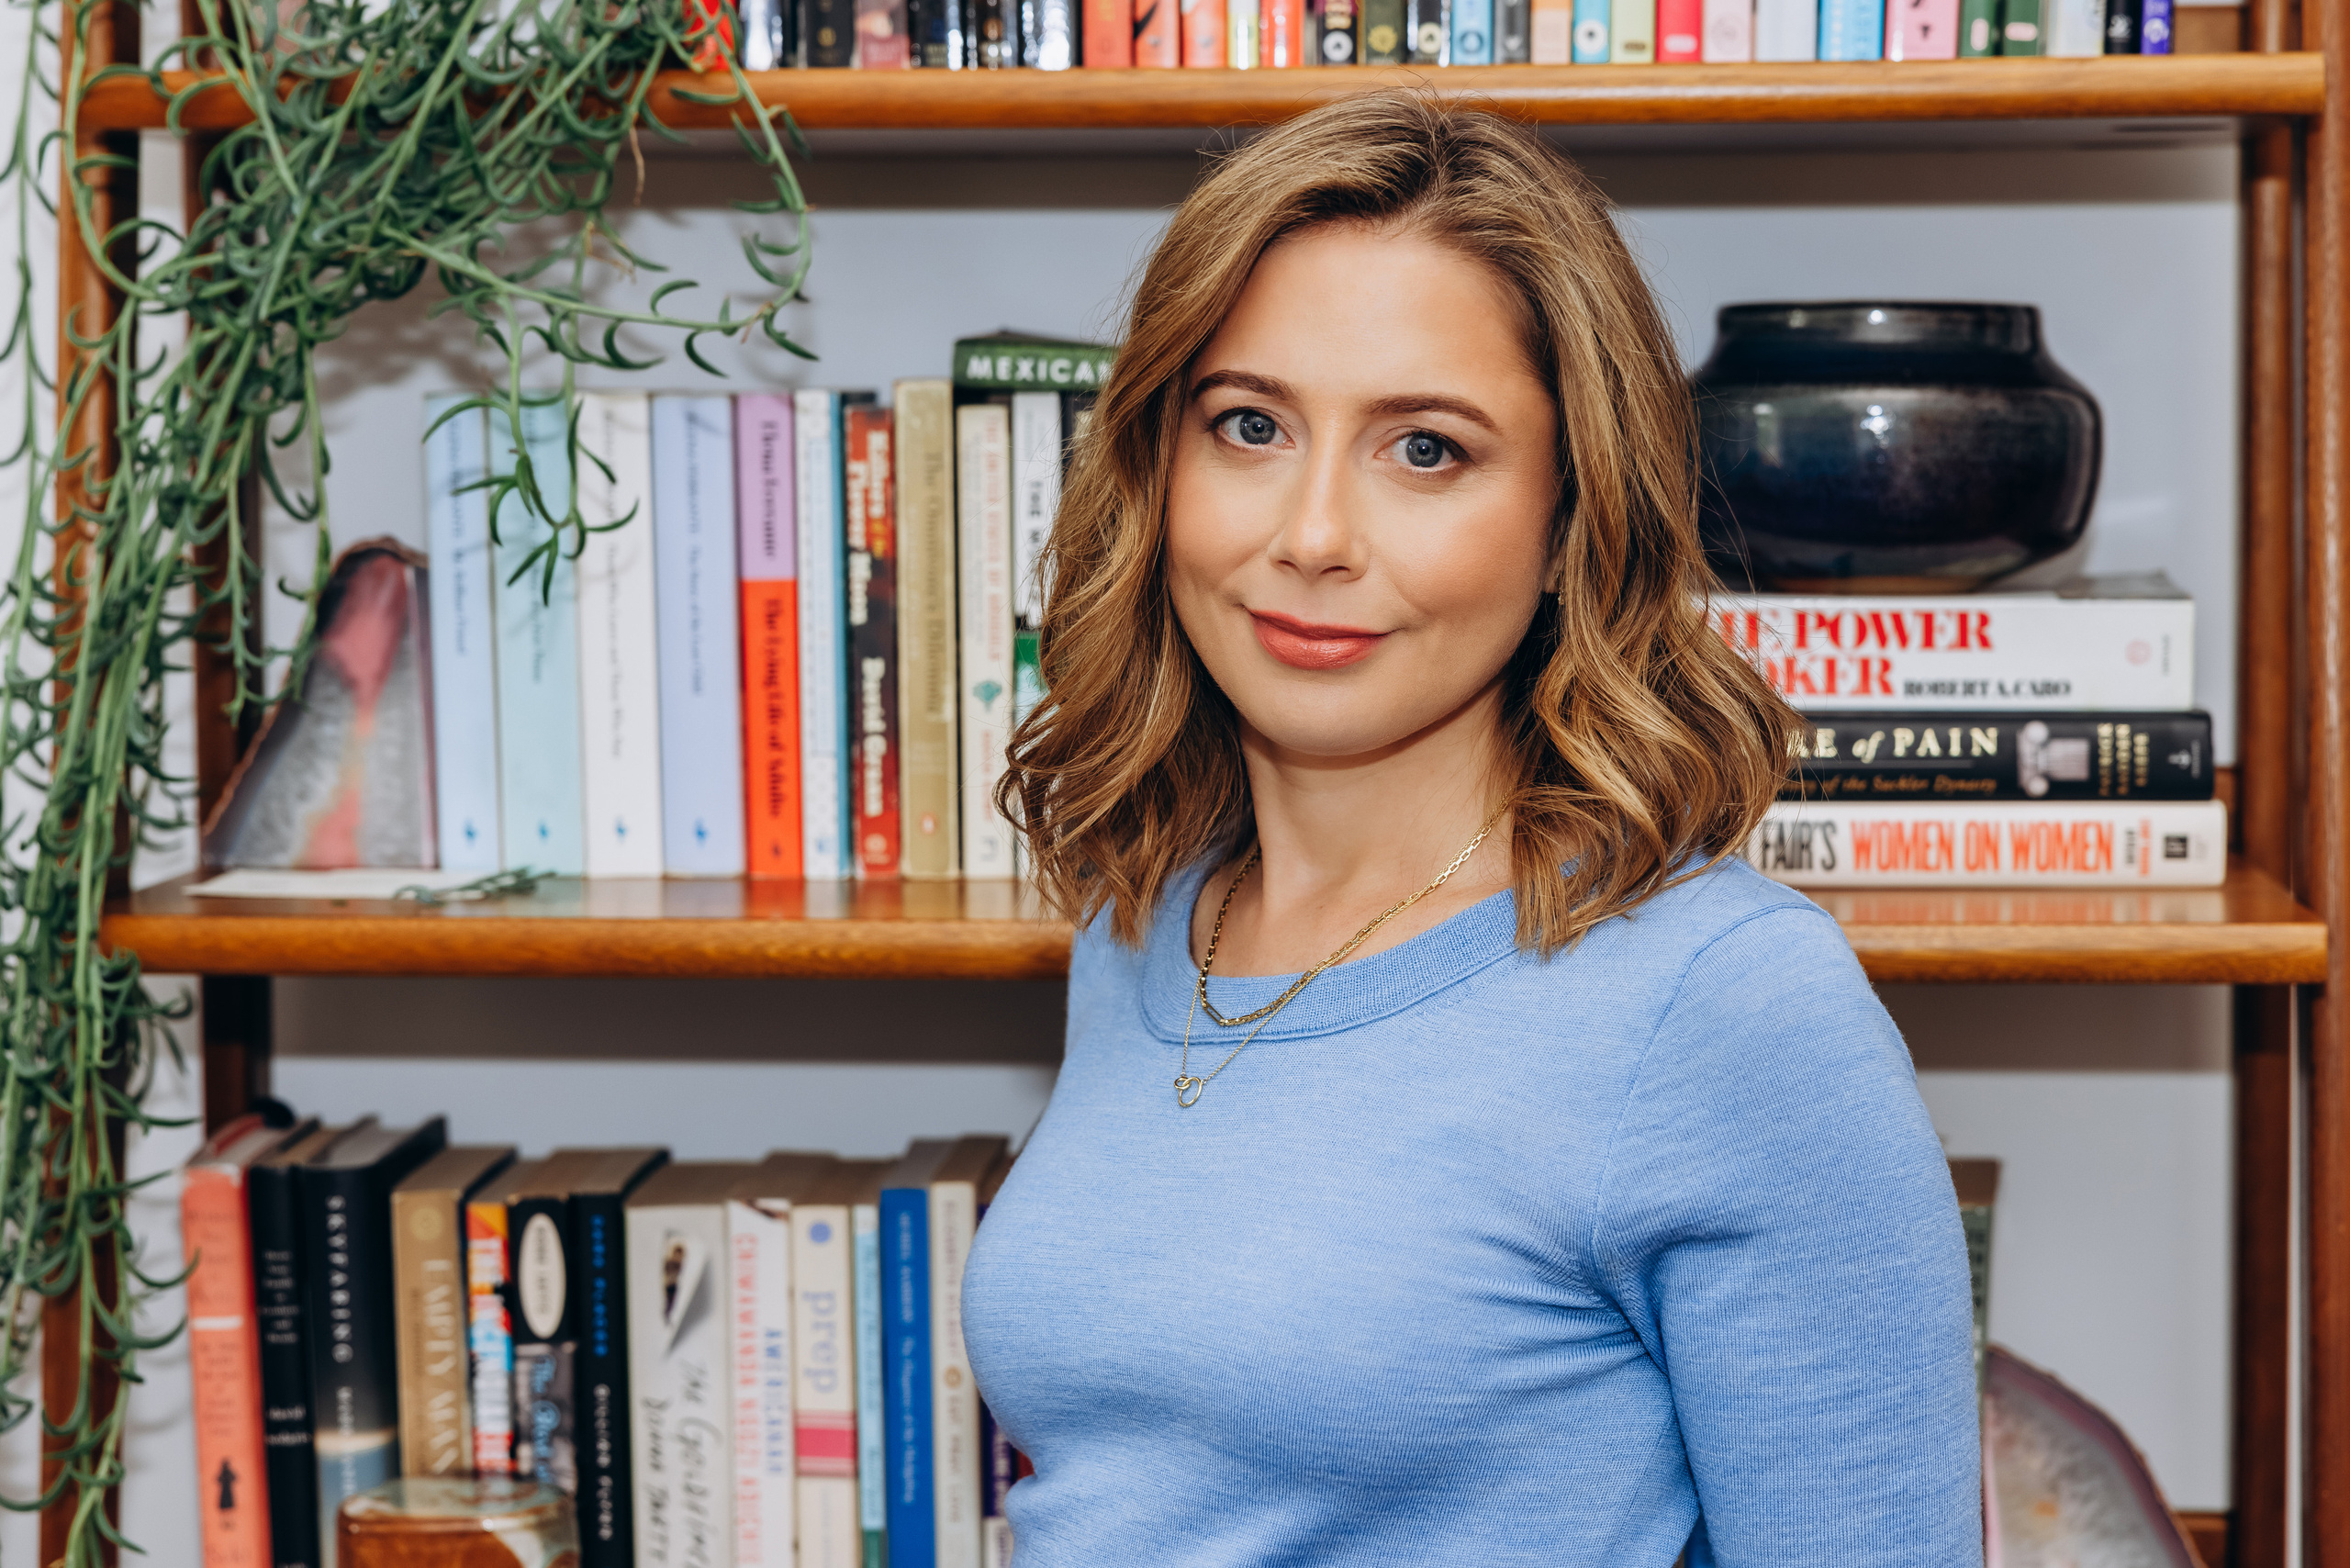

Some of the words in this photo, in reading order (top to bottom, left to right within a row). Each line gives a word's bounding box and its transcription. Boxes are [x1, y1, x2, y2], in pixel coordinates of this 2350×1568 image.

[765, 599, 783, 631] The
[1794, 609, 1993, 651] POWER
[862, 657, 886, 734] David
[864, 735, 887, 817] Grann
[1852, 730, 1886, 764] of
[1893, 726, 1999, 757] PAIN
[1849, 819, 1955, 872] WOMEN
[1964, 819, 2001, 872] ON
[2009, 819, 2114, 873] WOMEN
[325, 1194, 354, 1364] SKYFARING
[803, 1290, 840, 1394] prep
